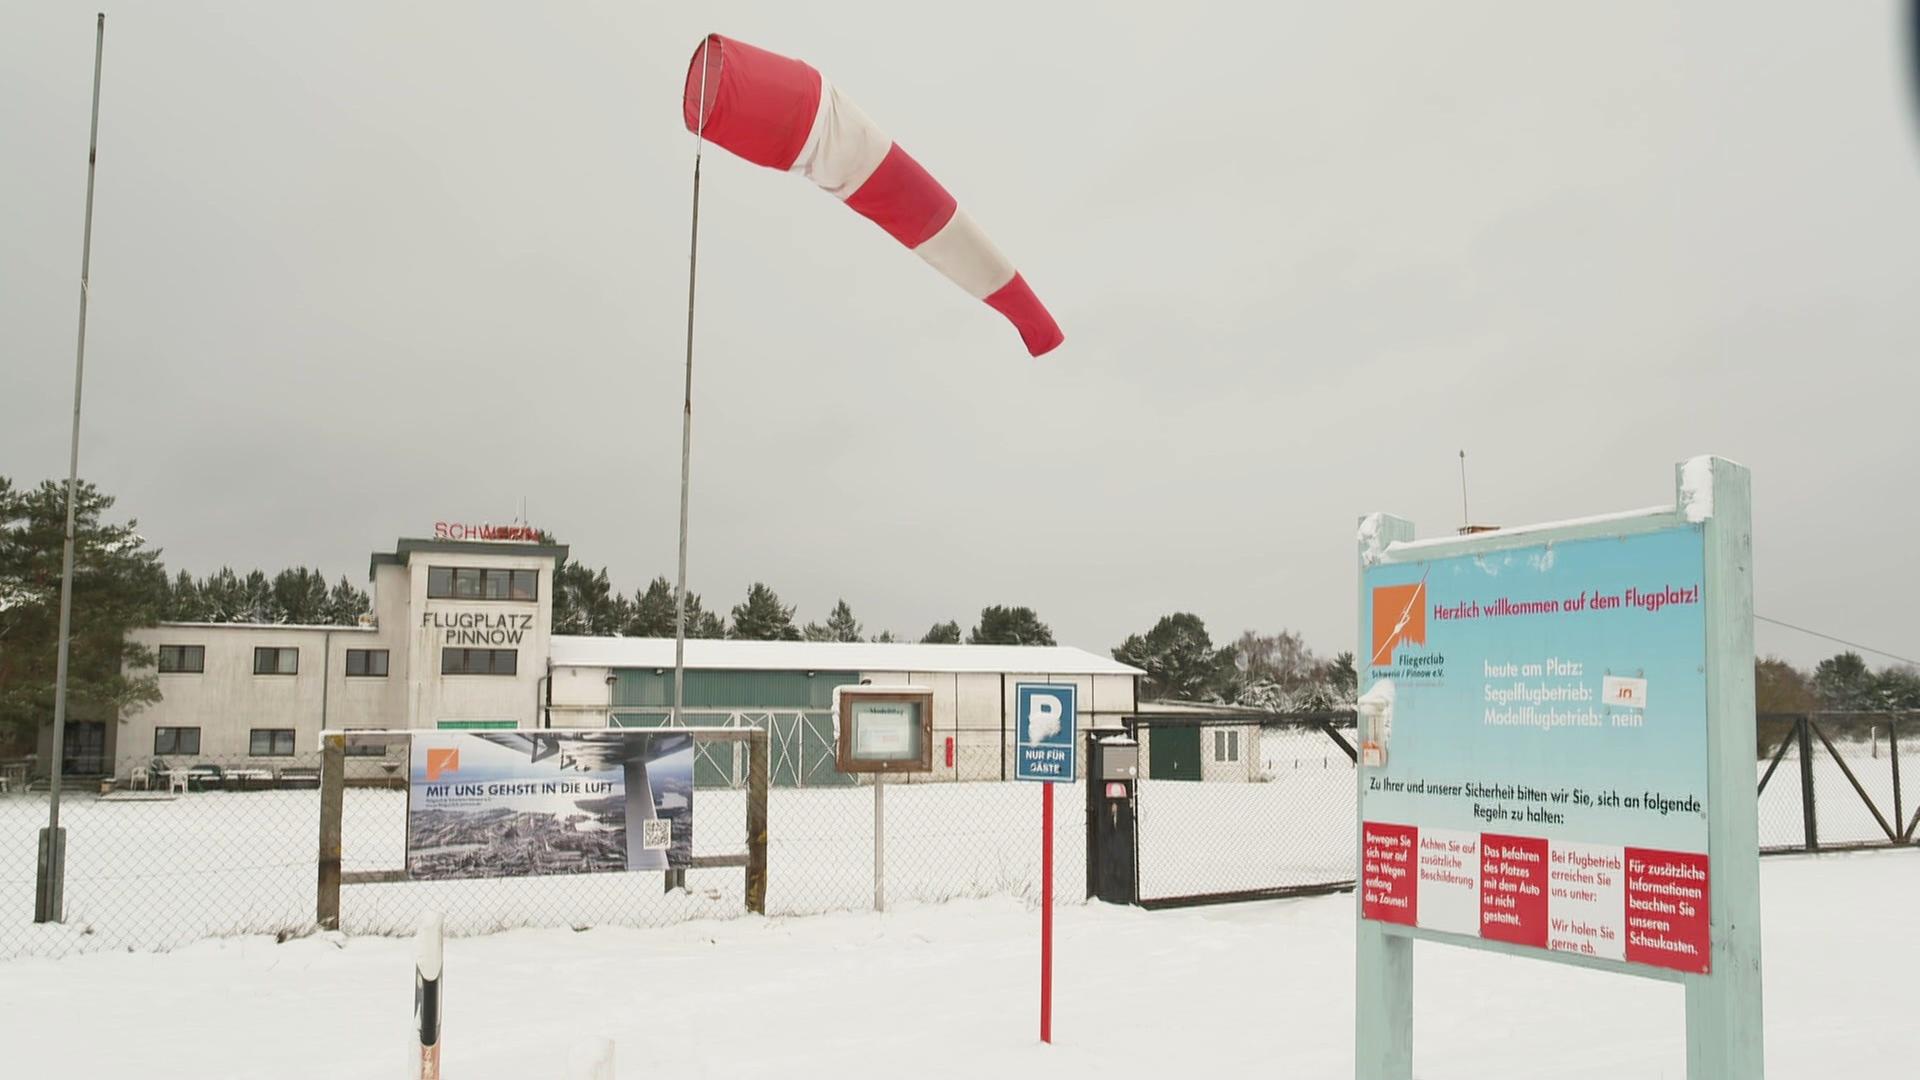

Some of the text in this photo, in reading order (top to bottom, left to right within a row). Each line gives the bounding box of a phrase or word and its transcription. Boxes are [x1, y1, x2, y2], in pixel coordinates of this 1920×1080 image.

[1434, 584, 1698, 620] Herzlich willkommen auf dem Flugplatz!
[423, 612, 533, 629] FLUGPLATZ
[446, 630, 524, 645] PINNOW
[1399, 652, 1445, 668] Fliegerclub
[1484, 657, 1583, 678] heute am Platz:
[1406, 669, 1430, 678] Pinnow
[1432, 669, 1445, 678] e.V.
[1484, 682, 1593, 705] Segelflugbetrieb:
[1030, 694, 1063, 735] P
[1484, 706, 1643, 731] Modellflugbetrieb: nein
[1025, 749, 1065, 761] NUR FÜR
[1030, 761, 1060, 774] GÄSTE
[426, 781, 614, 797] MIT UNS GEHSTE IN DIE LUFT
[1370, 777, 1701, 816] Zu Ihrer und unserer Sicherheit bitten wir Sie, sich an folgende
[1474, 803, 1564, 824] Regeln zu halten:
[1366, 830, 1411, 848] Bewegen Sie
[1420, 838, 1475, 854] Achten Sie auf
[1366, 846, 1407, 862] sich nur auf
[1421, 855, 1462, 868] zusätzliche
[1484, 845, 1540, 863] Das Befahren
[1551, 850, 1621, 870] Bei Flugbetrieb
[1366, 859, 1406, 879] den Wegen
[1484, 860, 1529, 878] des Platzes
[1551, 869, 1611, 887] erreichen Sie
[1629, 859, 1706, 880] Für zusätzliche
[1365, 876, 1392, 893] entlang
[1420, 869, 1474, 889] Beschilderung
[1484, 877, 1540, 896] mit dem Auto
[1629, 876, 1702, 899] Informationen
[1365, 889, 1408, 908] des Zaunes!
[1484, 893, 1515, 909] ist nicht
[1551, 888, 1597, 903] uns unter:
[1629, 894, 1695, 916] beachten Sie
[1483, 911, 1520, 926] gestattet.
[1629, 916, 1670, 932] unseren
[1551, 919, 1615, 940] Wir holen Sie
[1551, 939, 1596, 955] gerne ab.
[1629, 931, 1698, 956] Schaukasten.
